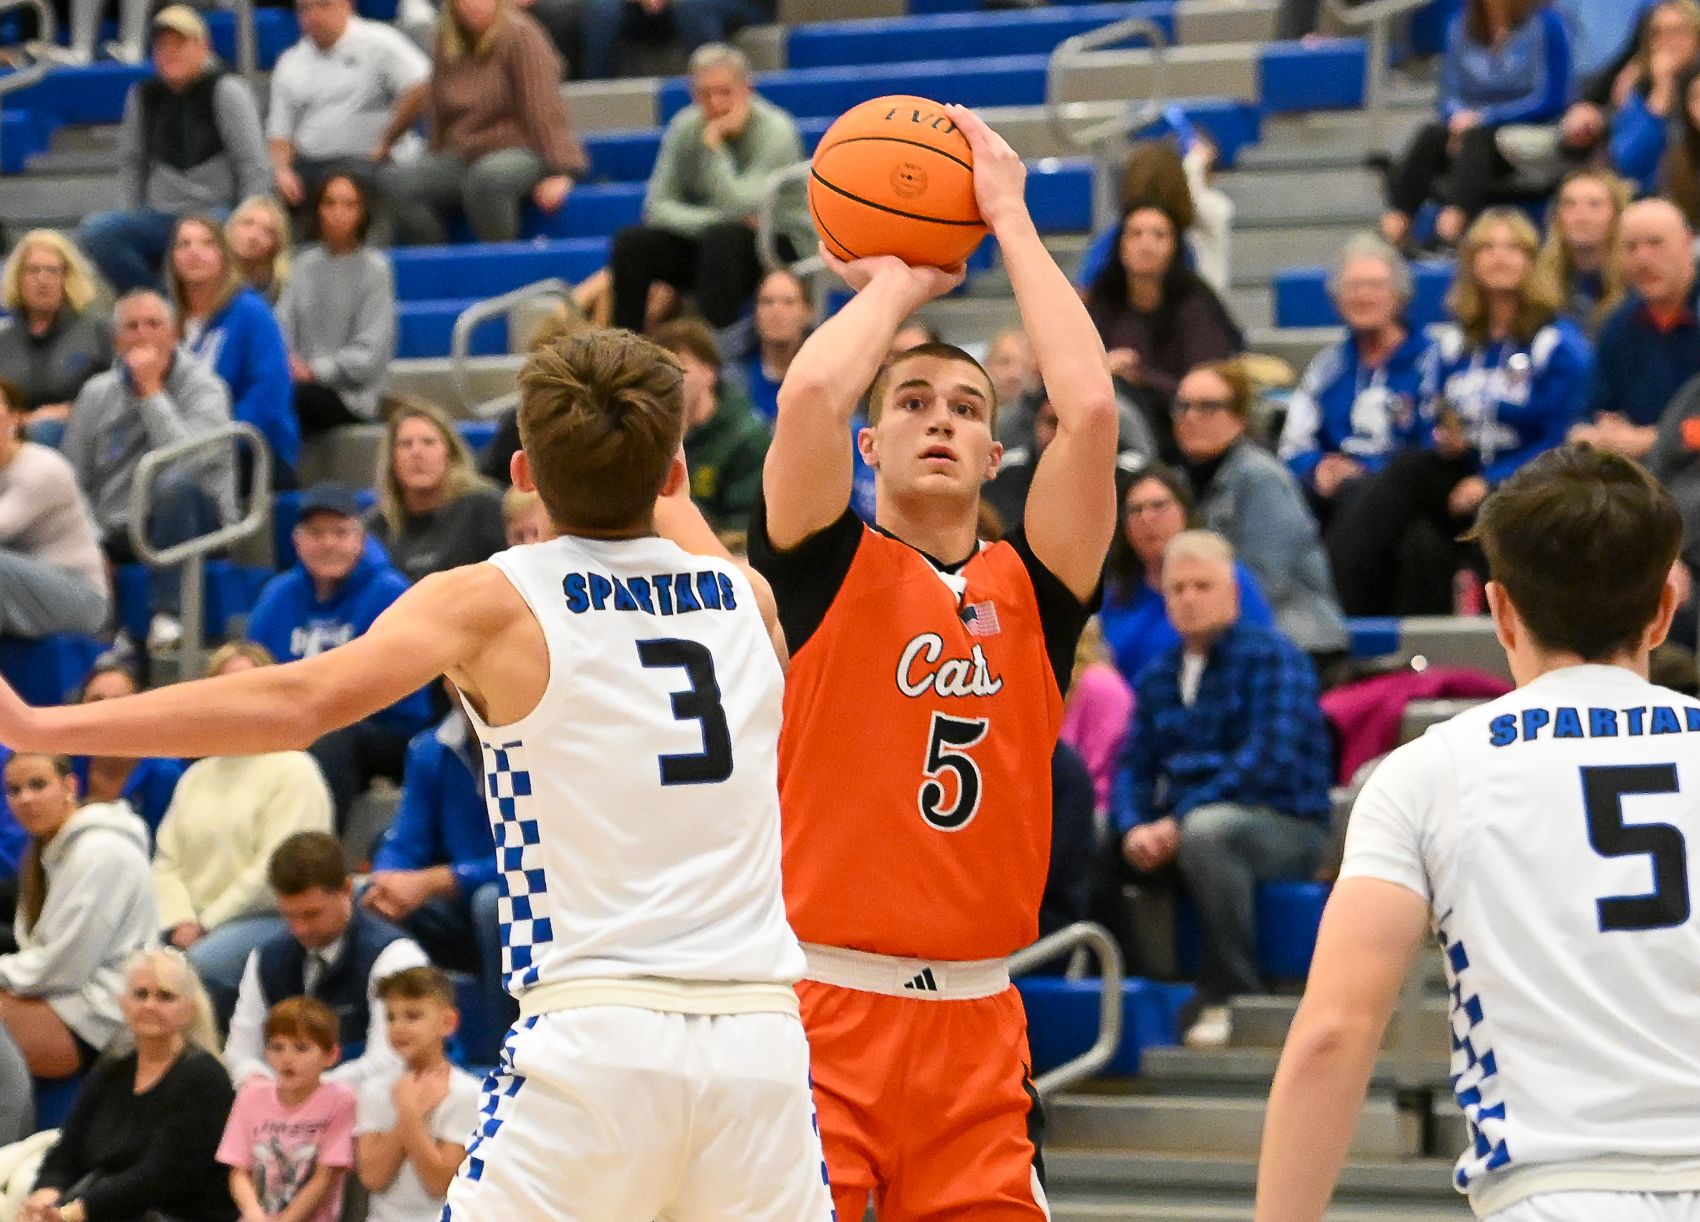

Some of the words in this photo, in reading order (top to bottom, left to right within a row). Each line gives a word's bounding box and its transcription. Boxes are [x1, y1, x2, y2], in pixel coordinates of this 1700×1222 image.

[562, 571, 737, 616] SPARTANS
[635, 637, 733, 786] 3
[917, 710, 989, 832] 5
[1578, 762, 1691, 933] 5
